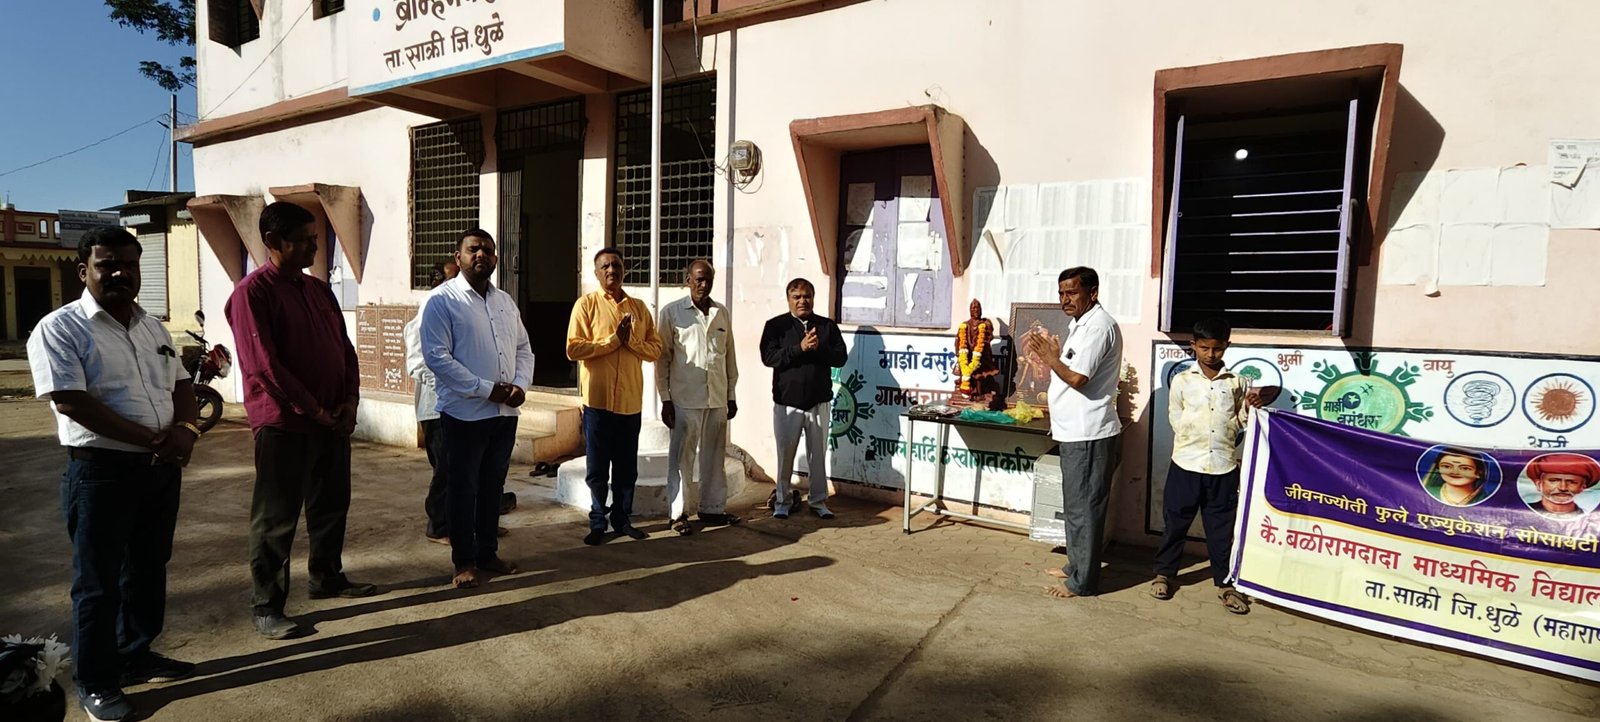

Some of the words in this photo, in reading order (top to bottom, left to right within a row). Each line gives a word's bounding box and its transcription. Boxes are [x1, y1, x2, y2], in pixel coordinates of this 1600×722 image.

[878, 345, 921, 372] माझी
[1277, 350, 1304, 372] भुमी
[1423, 359, 1455, 378] वायु
[951, 446, 998, 473] स्वागत
[999, 446, 1034, 480] करि
[1284, 483, 1368, 515] जीवनज्योती
[1375, 505, 1409, 523] फुले
[1416, 513, 1507, 540] एज्युकेशन
[1514, 526, 1600, 553] सोसायटी
[1413, 555, 1520, 593] माध्यमिक
